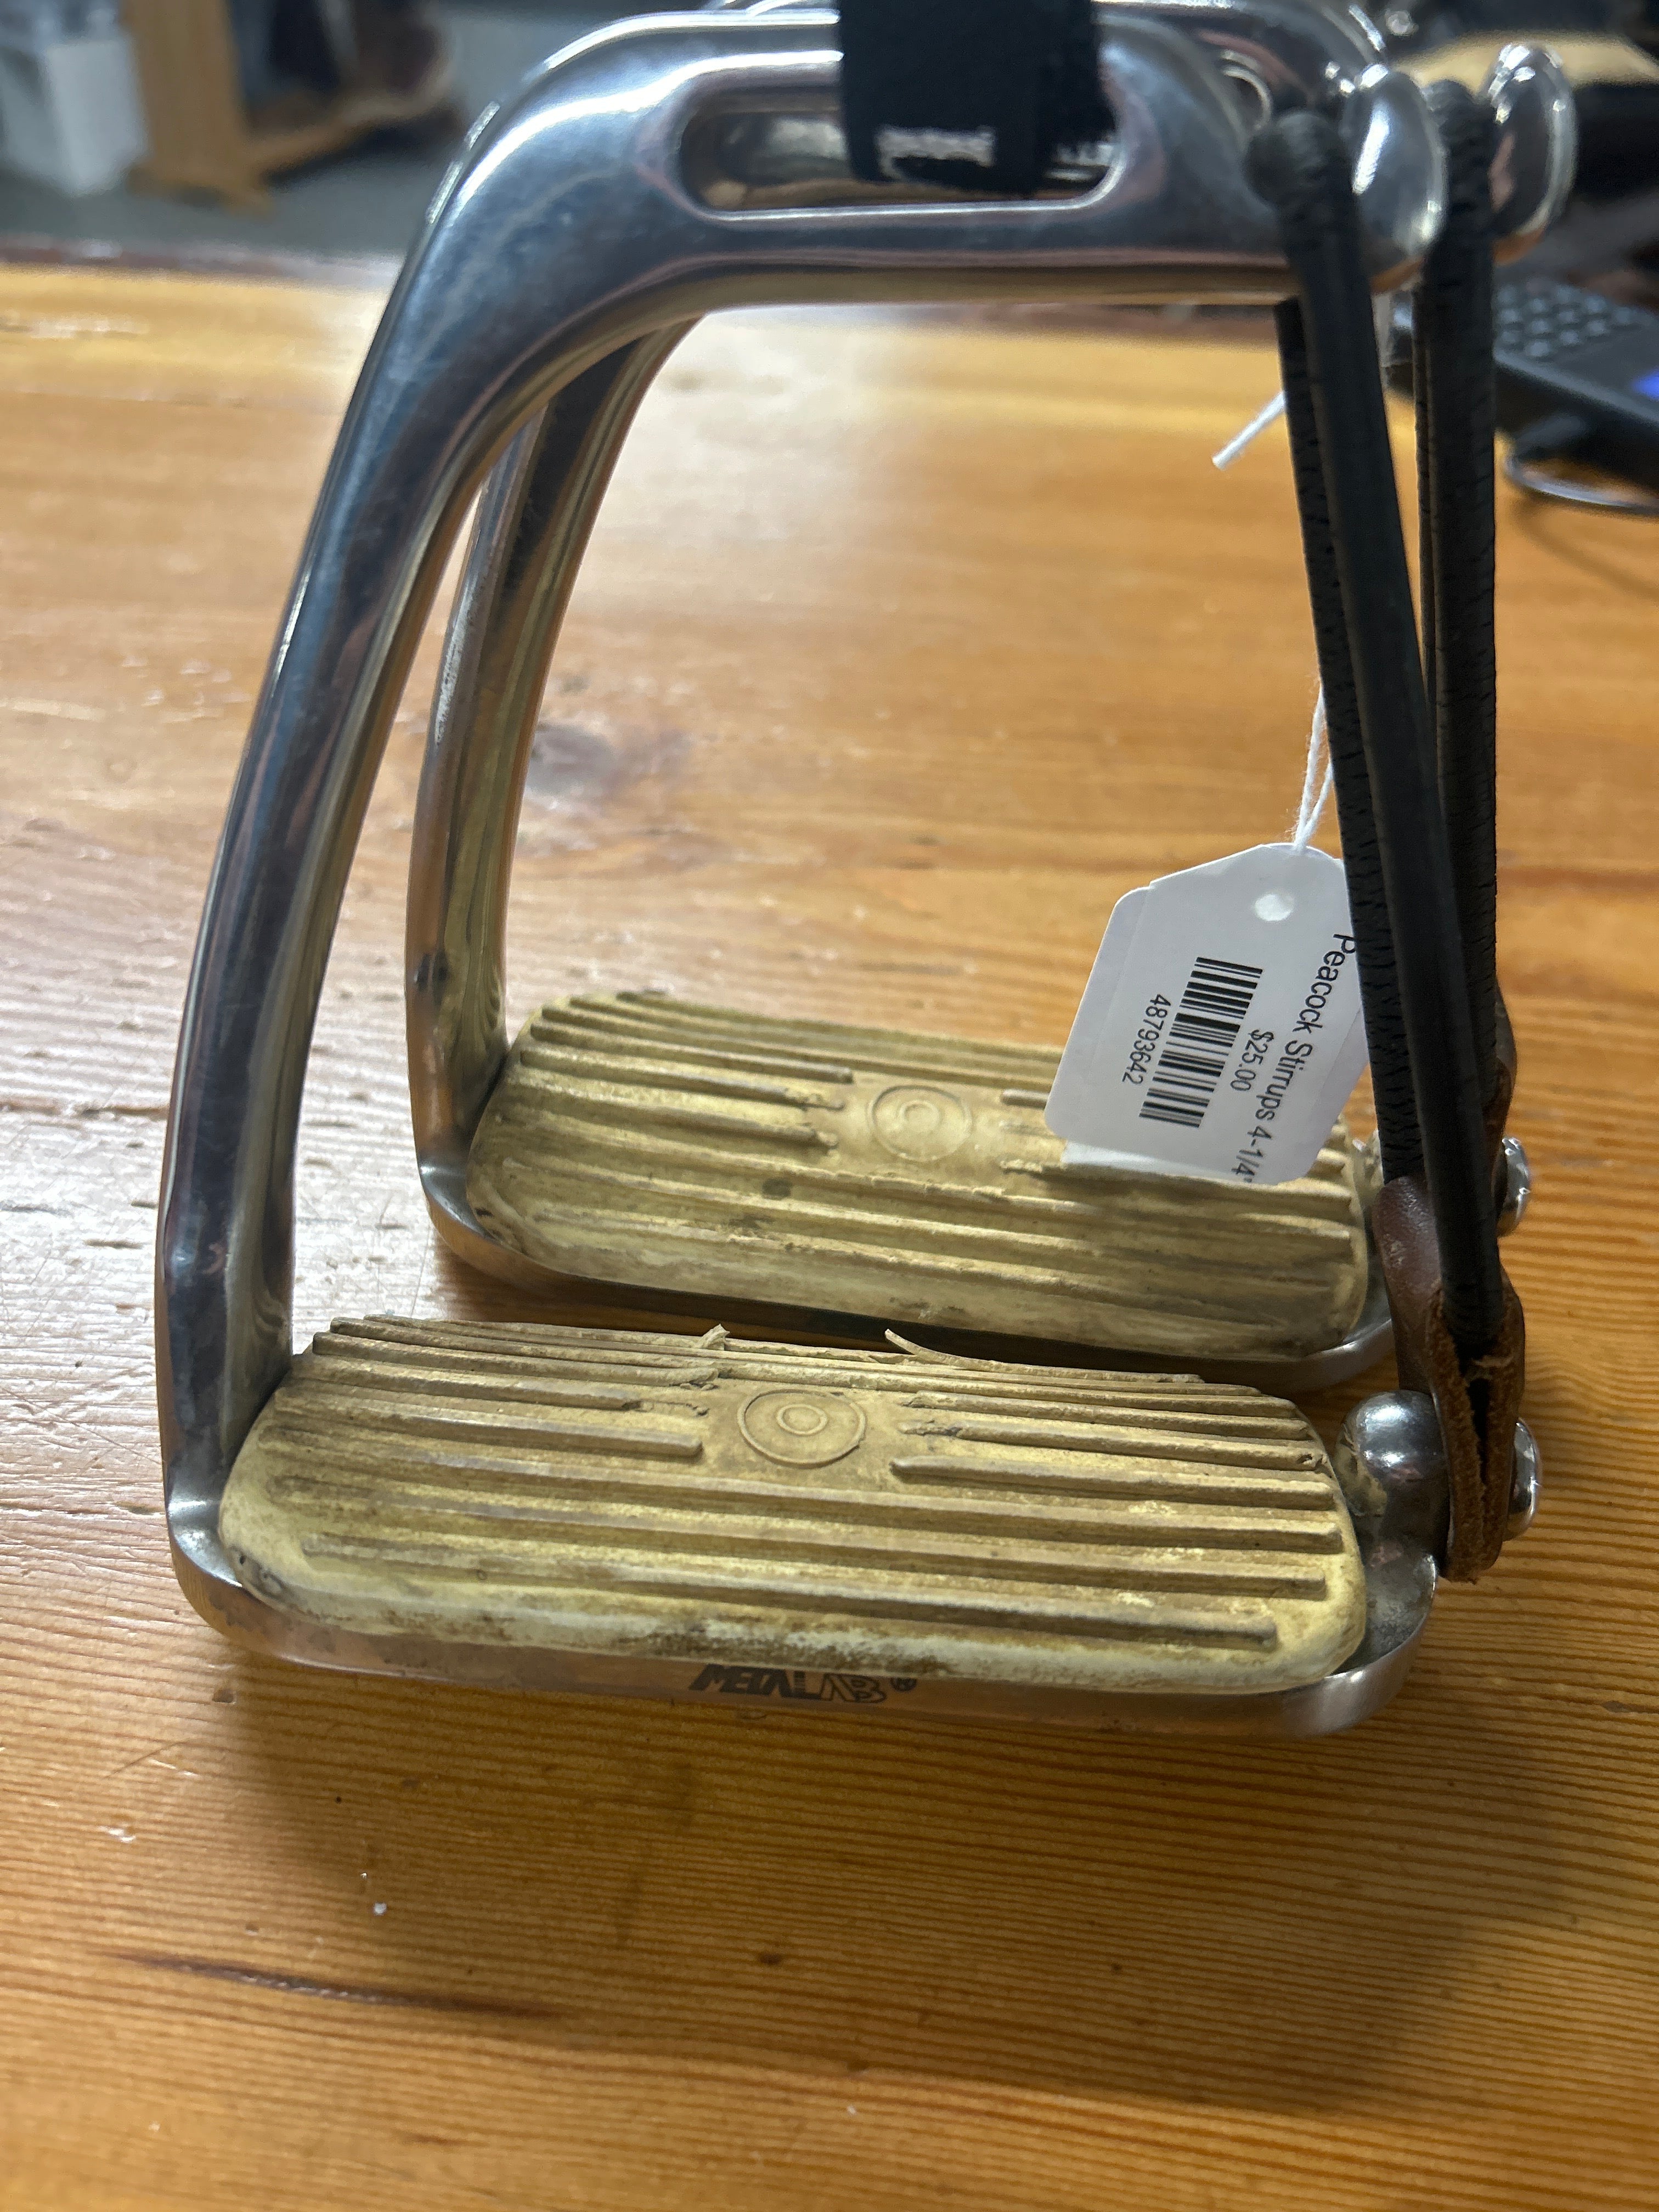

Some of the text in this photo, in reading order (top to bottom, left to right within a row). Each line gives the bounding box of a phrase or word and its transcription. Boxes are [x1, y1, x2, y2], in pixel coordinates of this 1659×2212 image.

[1292, 934, 1357, 1034] Peacock
[1122, 994, 1171, 1084] 48793642
[1231, 1029, 1274, 1092] $25.00
[1255, 1039, 1312, 1121] Stirrups
